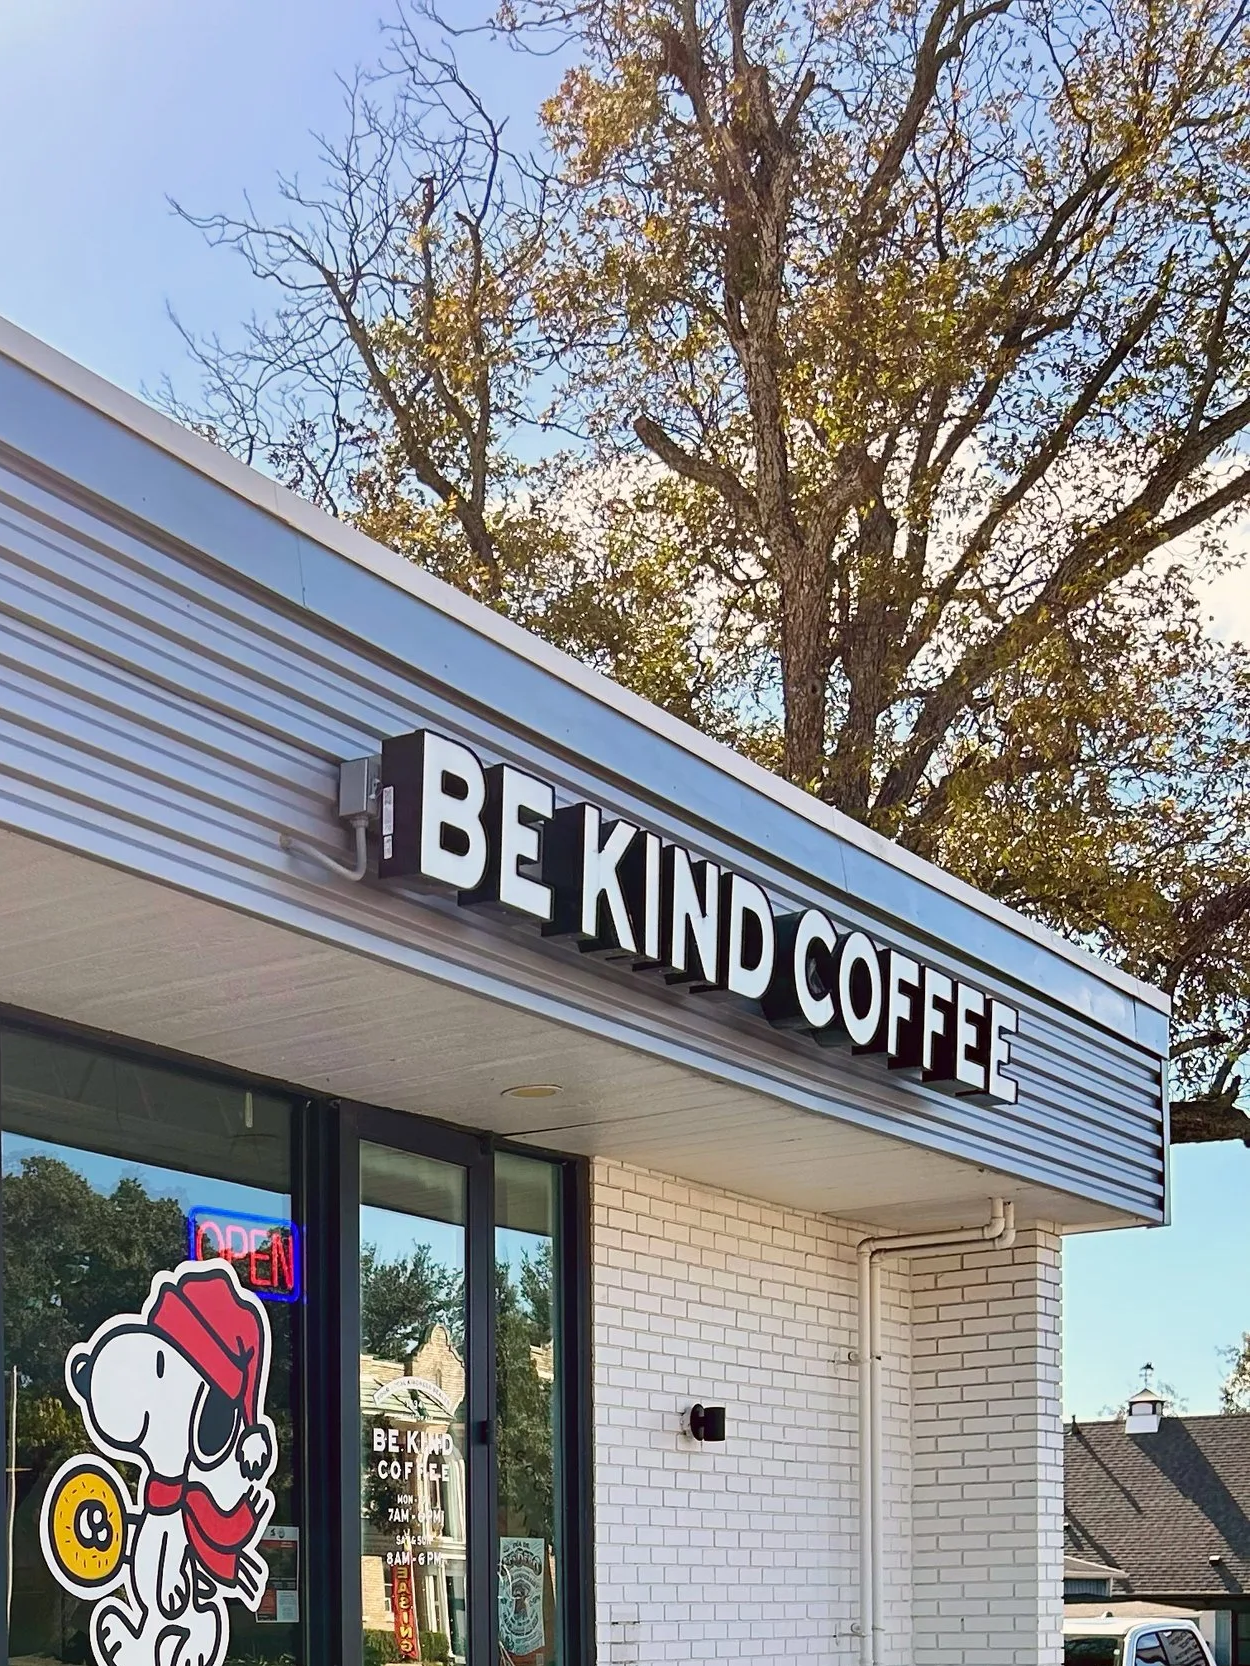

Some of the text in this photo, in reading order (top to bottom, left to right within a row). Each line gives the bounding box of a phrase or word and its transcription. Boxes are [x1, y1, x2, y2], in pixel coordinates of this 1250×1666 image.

[420, 728, 1020, 1104] BE KIND COFFEE
[196, 1220, 294, 1290] OPEN
[373, 1427, 454, 1456] BE KIND
[377, 1460, 450, 1482] COFFEE
[397, 1494, 414, 1505] MON
